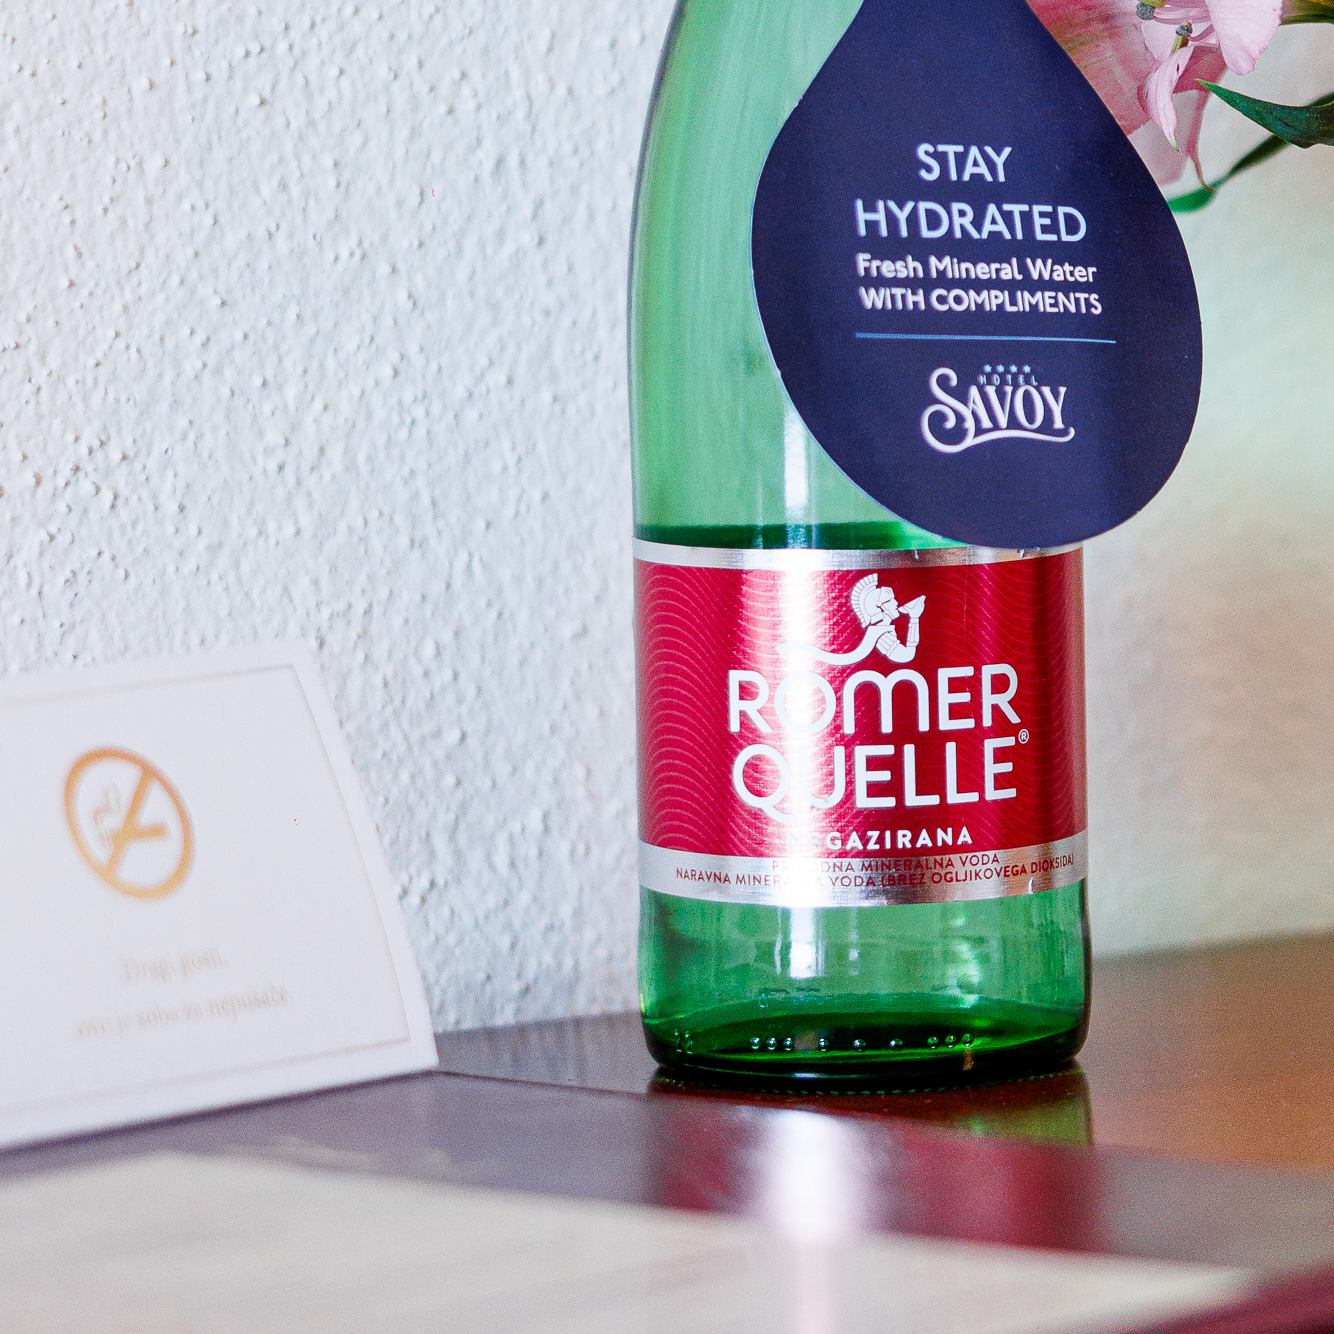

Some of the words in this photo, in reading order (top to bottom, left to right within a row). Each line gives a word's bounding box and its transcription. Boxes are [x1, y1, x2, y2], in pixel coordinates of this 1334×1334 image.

[917, 143, 1012, 183] STAY
[854, 199, 1088, 242] HYDRATED
[856, 253, 923, 279] Fresh
[929, 255, 1022, 282] Mineral
[1026, 258, 1097, 283] Water
[858, 287, 925, 311] WITH
[930, 288, 1102, 315] COMPLIMENTS
[977, 373, 1038, 386] HOTEL
[676, 867, 731, 885] NARAVNA
[829, 875, 876, 887] VODA
[931, 866, 1028, 883] OGLJIKOVEGA
[861, 856, 955, 873] MINERALNA
[959, 853, 1000, 867] VODA
